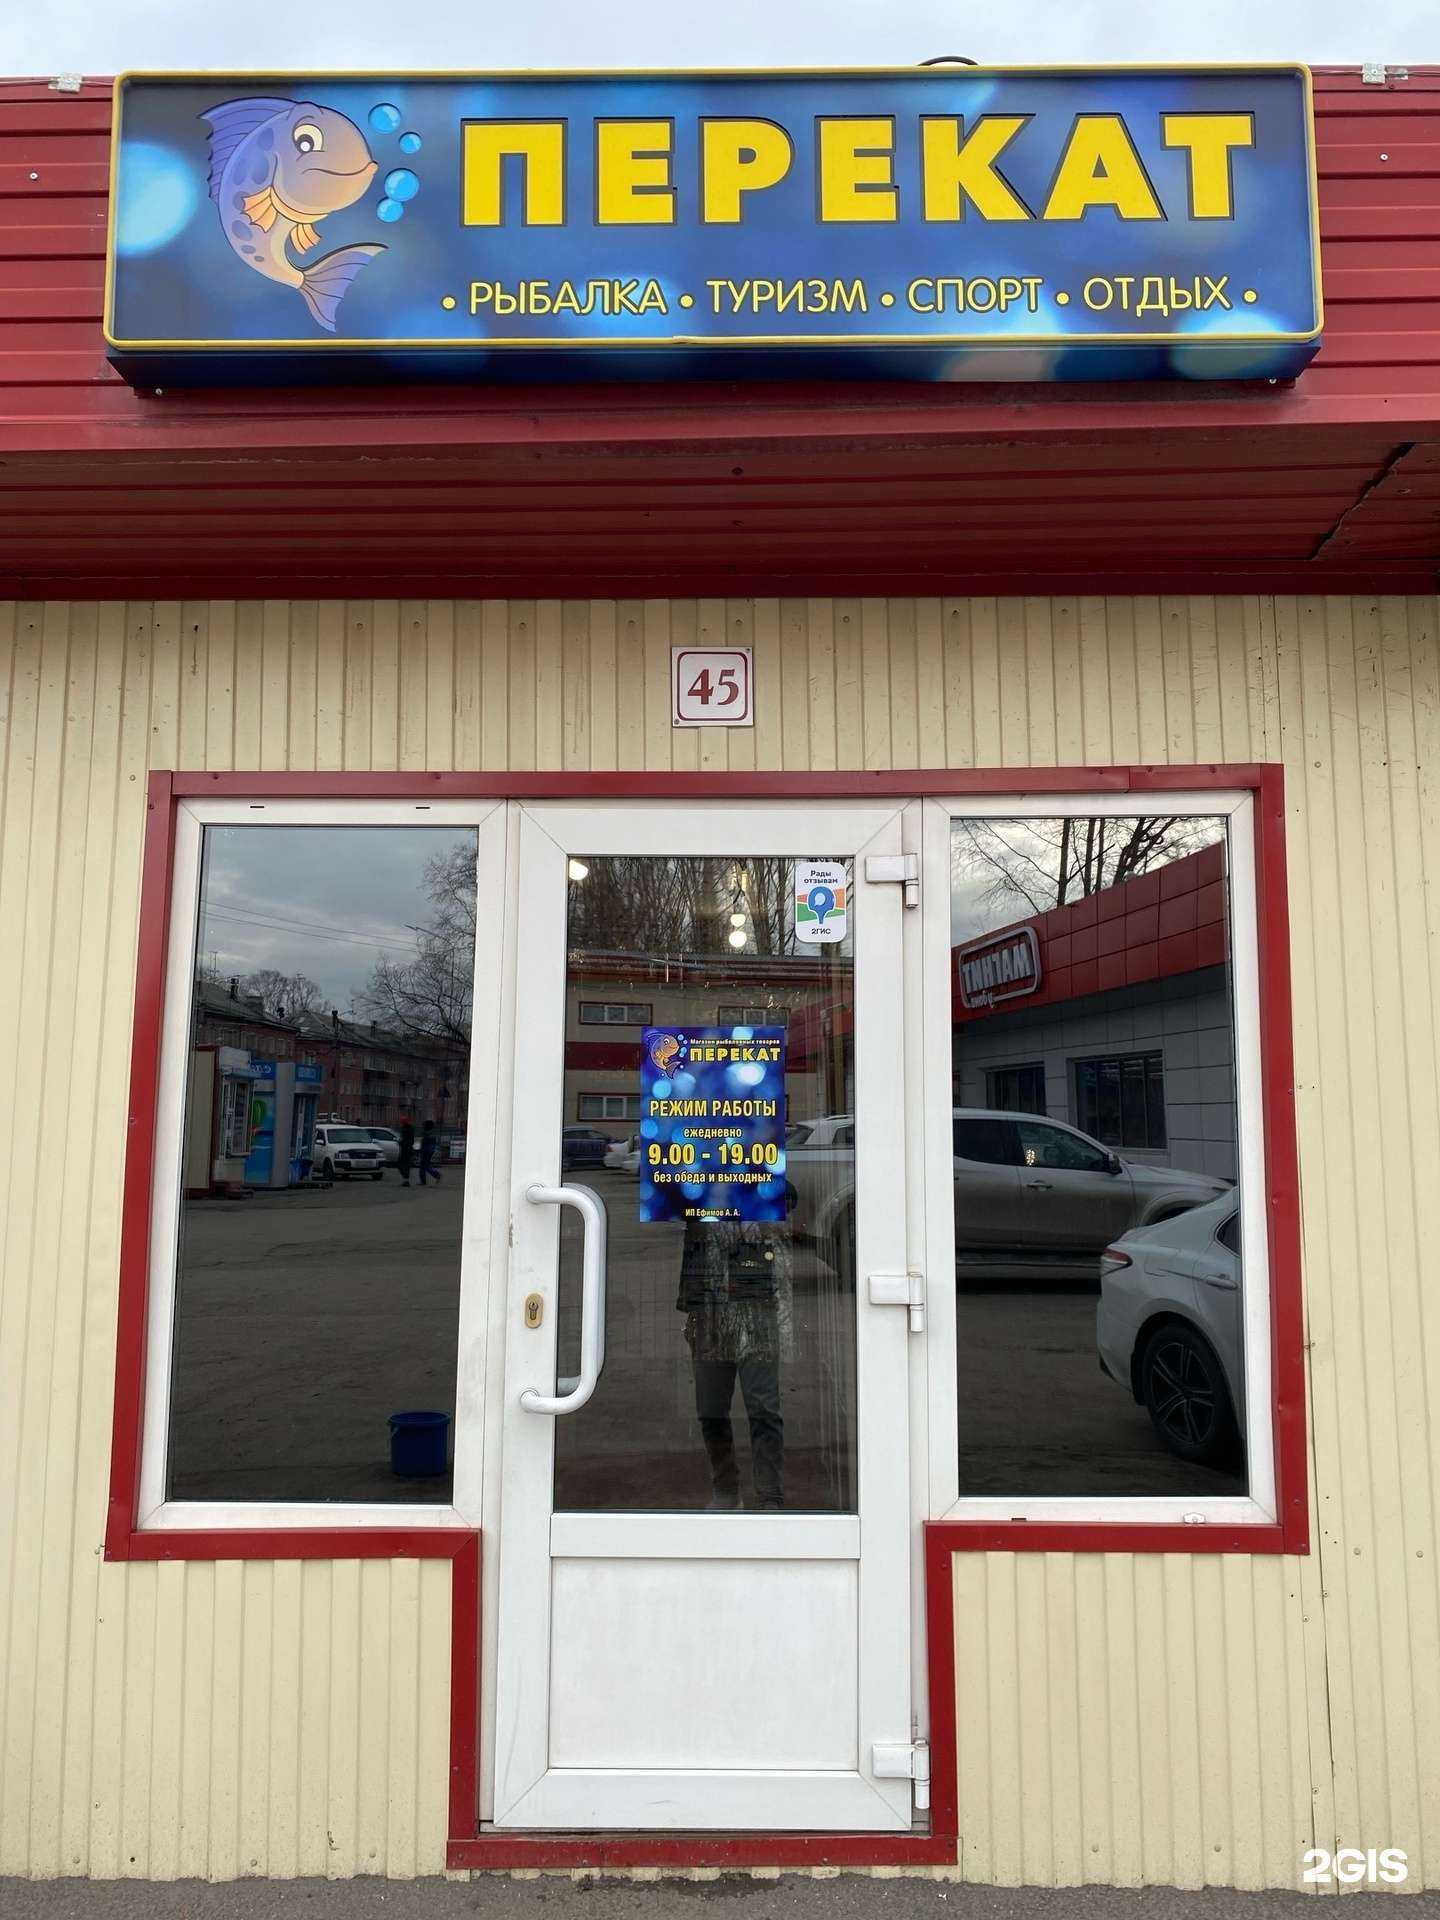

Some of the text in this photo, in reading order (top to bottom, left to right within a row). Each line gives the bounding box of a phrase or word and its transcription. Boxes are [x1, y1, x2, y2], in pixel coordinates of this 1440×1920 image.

[462, 114, 1255, 227] ПЕРЕКАТ
[469, 275, 1232, 317] РЫБАЛКА ТУРИЗМ СПОРТ ОТДЫХ
[687, 668, 739, 706] 45
[810, 870, 832, 878] Рады
[690, 1047, 781, 1062] ПЕРЕКАТ
[650, 1100, 776, 1117] РЕЖИМ РАБОТЫ
[684, 1127, 742, 1138] ежедневно
[648, 1143, 696, 1166] 9.00
[718, 1143, 778, 1166] 19.00
[653, 1171, 773, 1184] без обеда и выходных
[685, 1208, 741, 1218] ИП Ефимов А. А.
